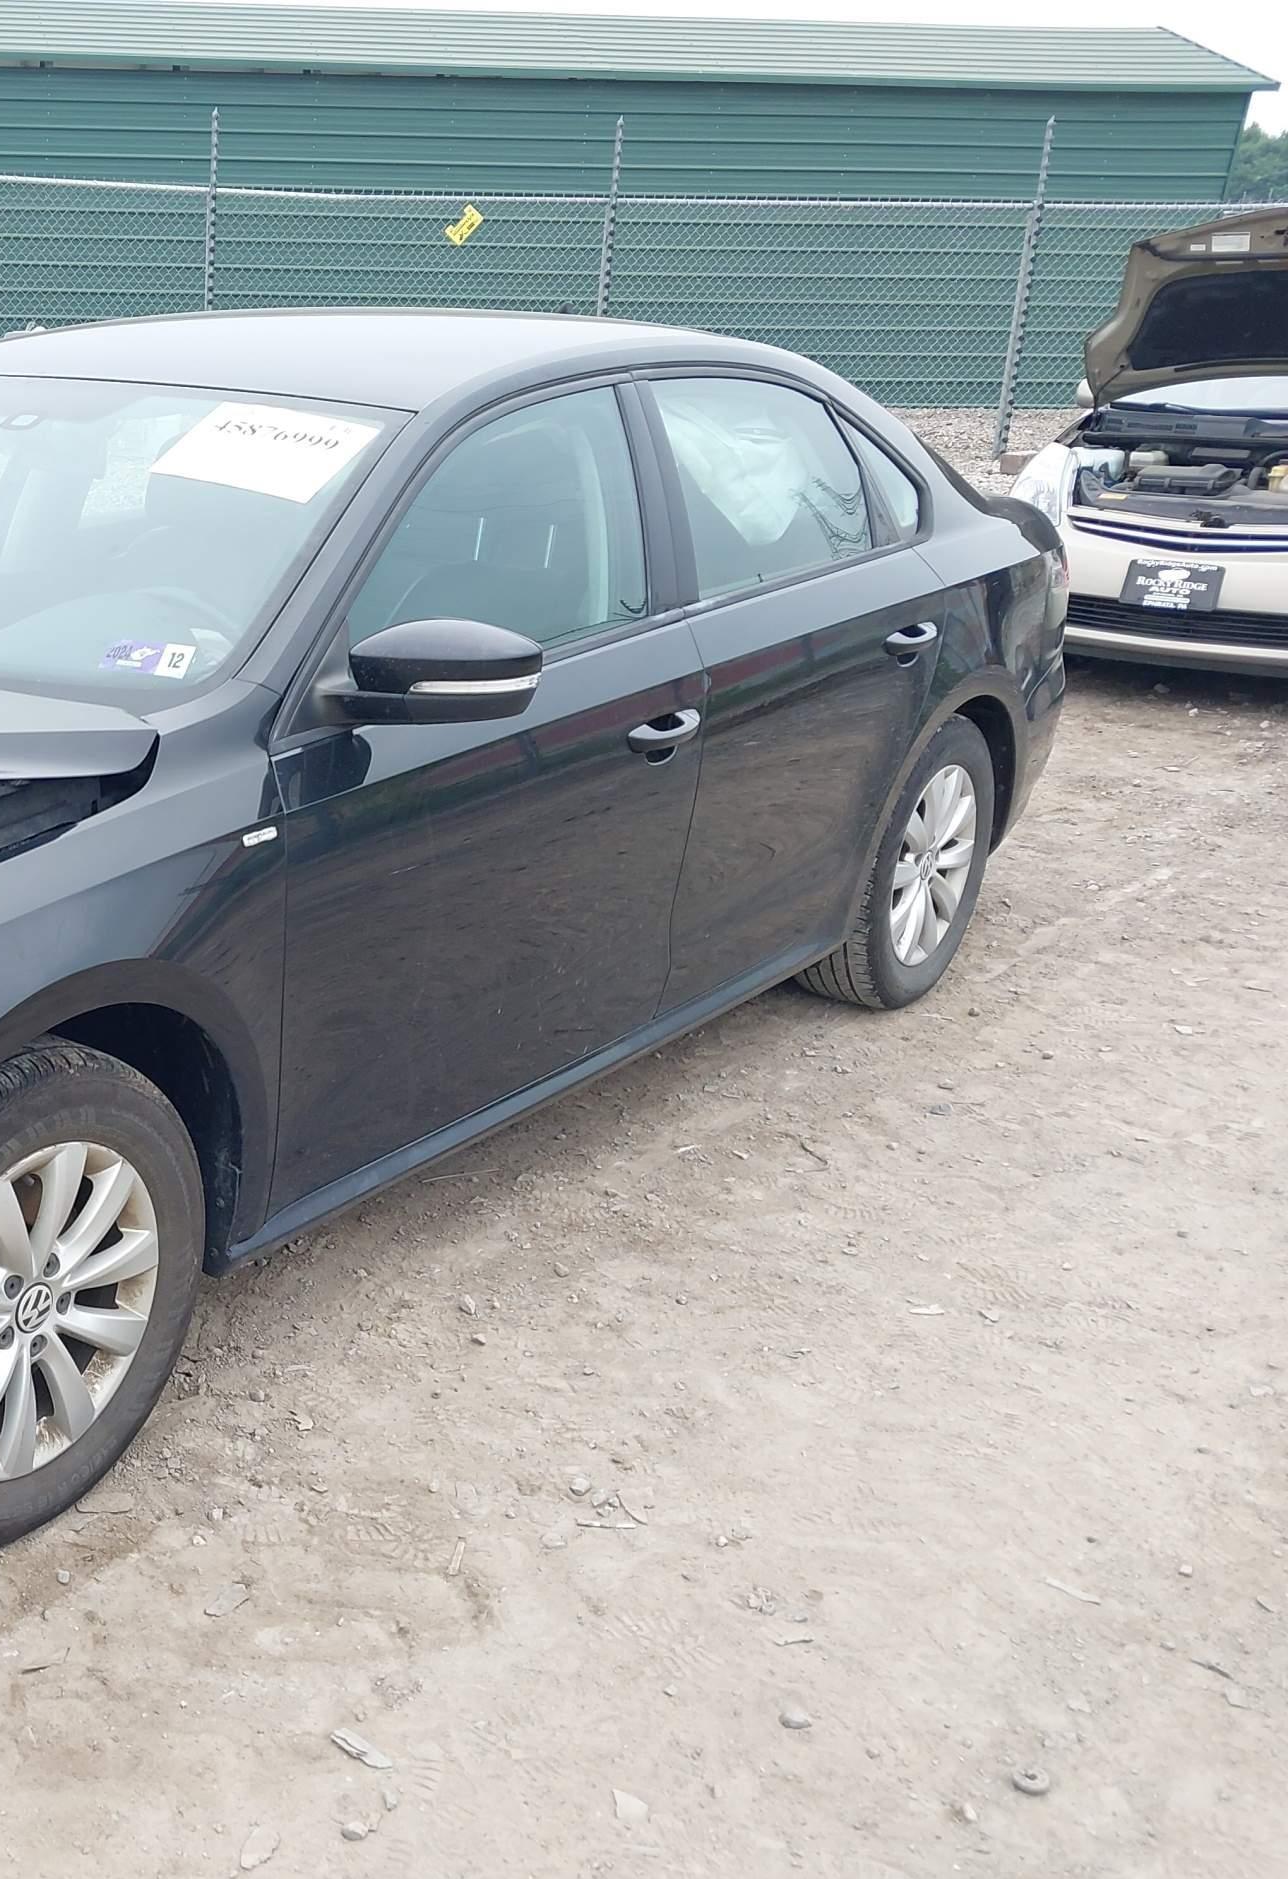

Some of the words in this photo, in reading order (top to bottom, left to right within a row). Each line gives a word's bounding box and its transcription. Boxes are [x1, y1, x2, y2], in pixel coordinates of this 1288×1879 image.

[1136, 576, 1171, 588] ROCKY
[1174, 579, 1208, 591] RIDGE
[1148, 586, 1191, 595] AUTO
[167, 652, 185, 669] 12
